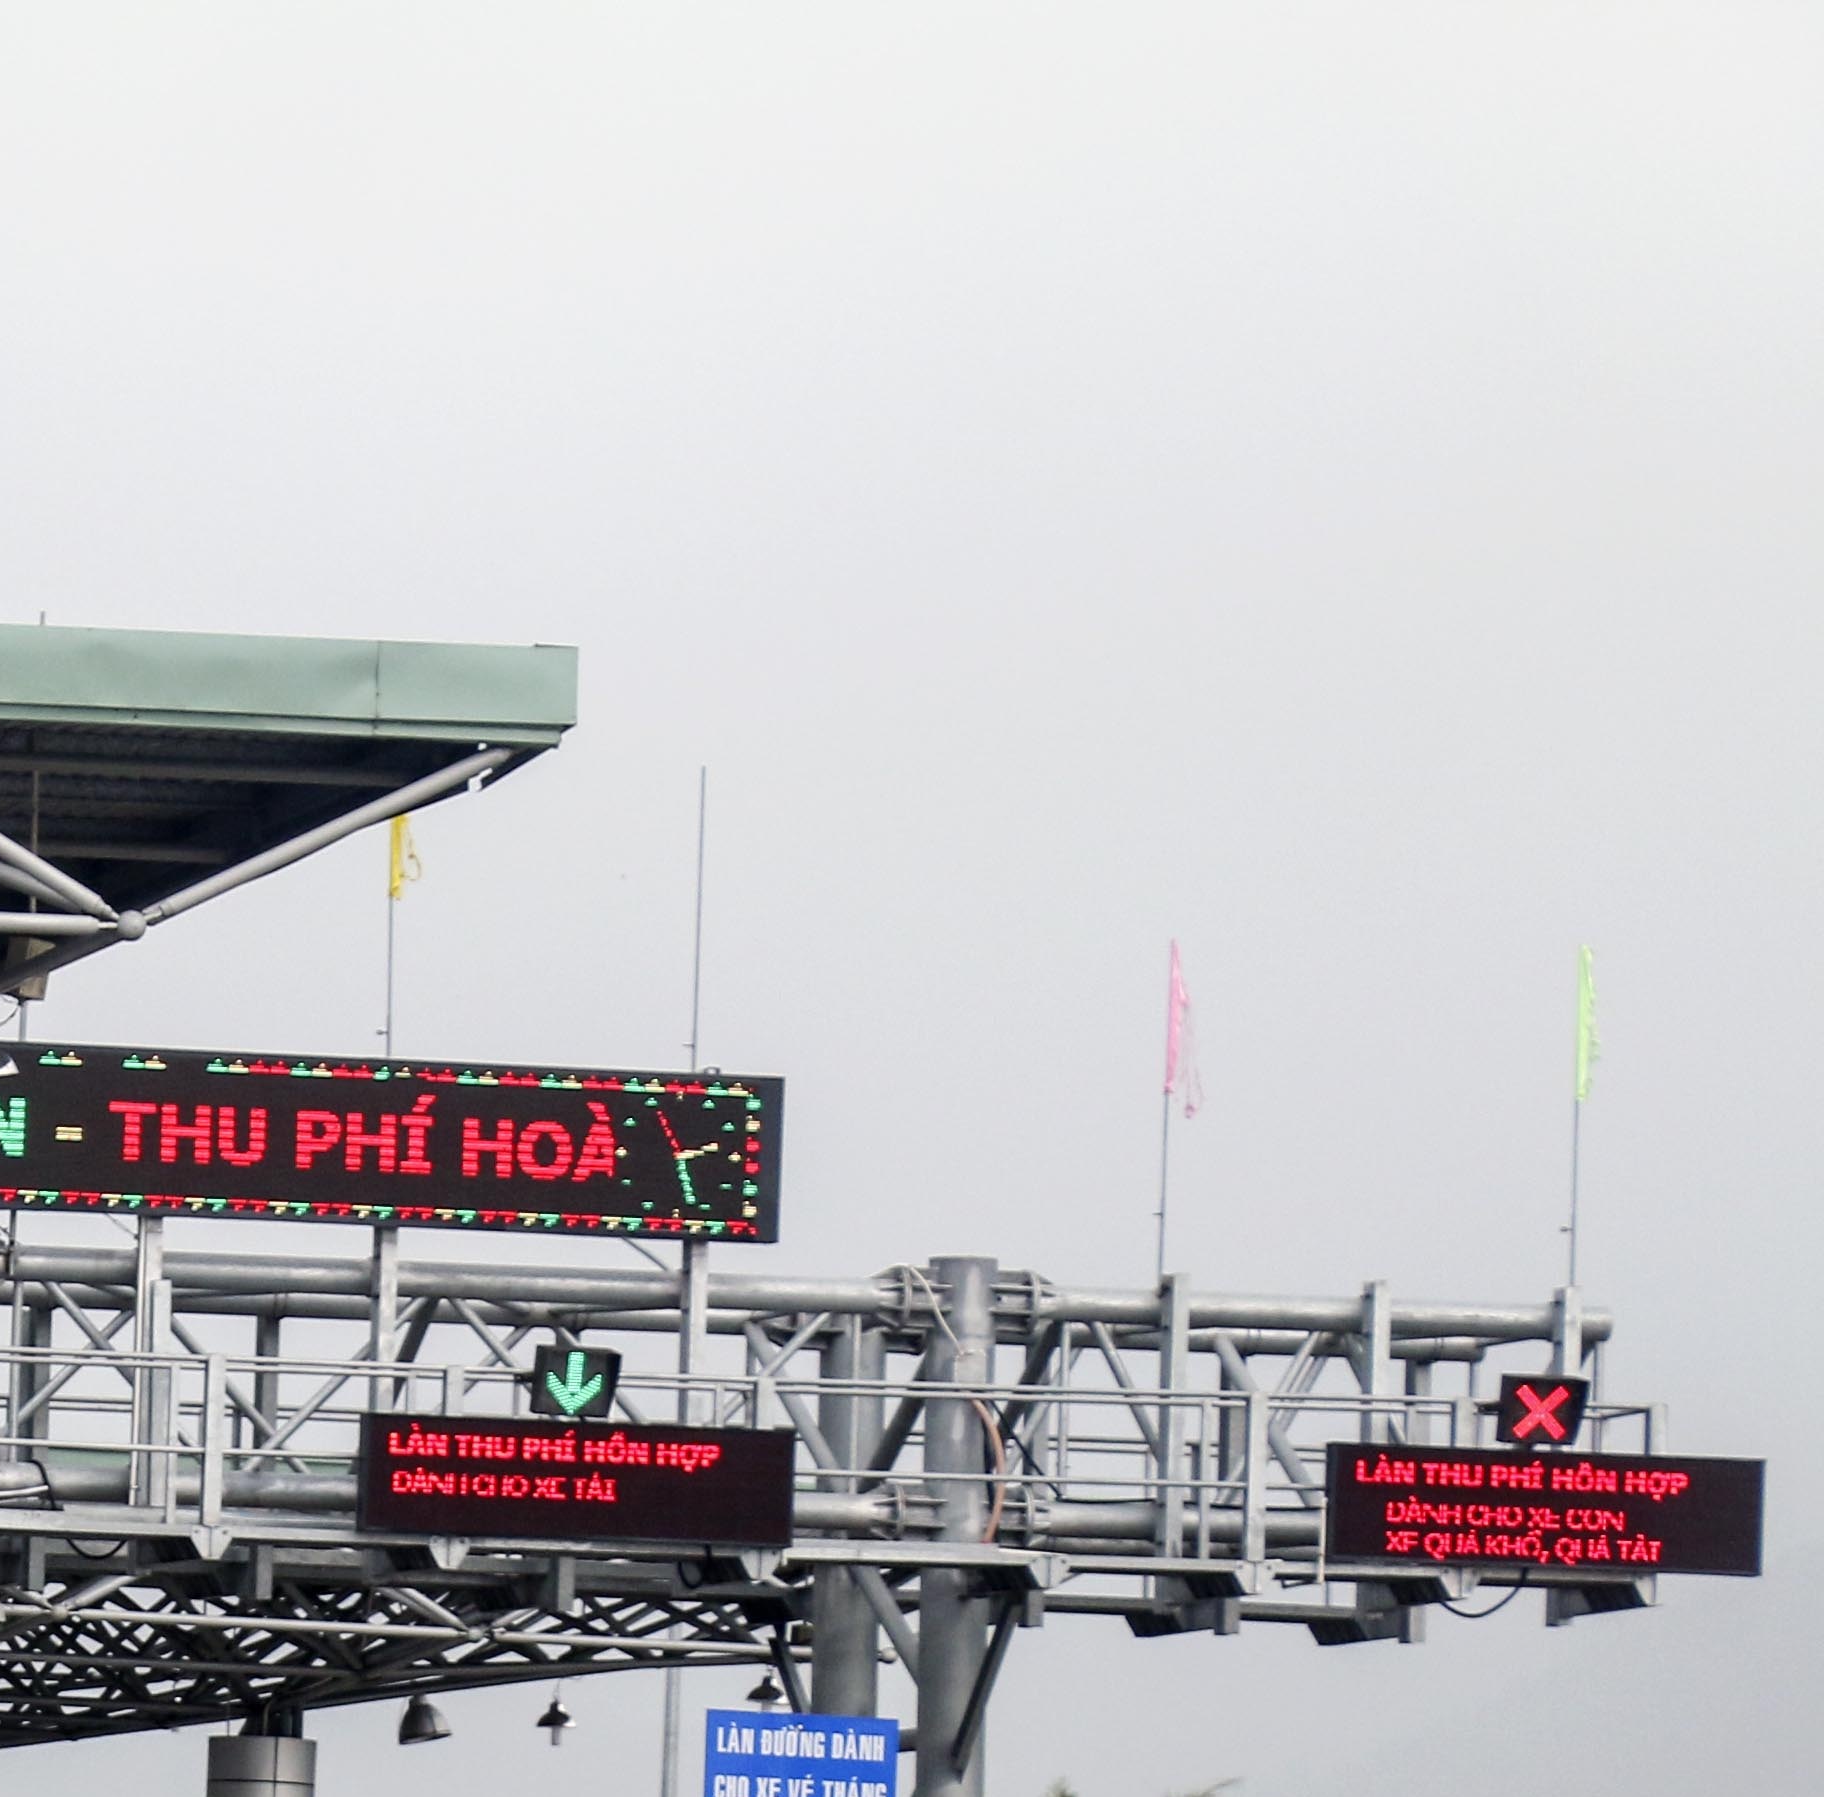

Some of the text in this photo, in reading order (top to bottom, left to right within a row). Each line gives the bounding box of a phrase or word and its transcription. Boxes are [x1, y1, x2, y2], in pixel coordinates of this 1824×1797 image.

[108, 1100, 268, 1168] THU
[295, 1094, 437, 1176] PHÍ
[388, 1423, 449, 1457] LÀN
[455, 1434, 517, 1460] THU
[522, 1430, 578, 1463] PHÍ
[1355, 1454, 1415, 1486] LÀN
[1422, 1461, 1483, 1489] THU
[1490, 1460, 1544, 1491] PHÍ
[1466, 1504, 1523, 1530] CHO
[717, 1722, 885, 1762] LÀN ĐƯỜNG DÀNH
